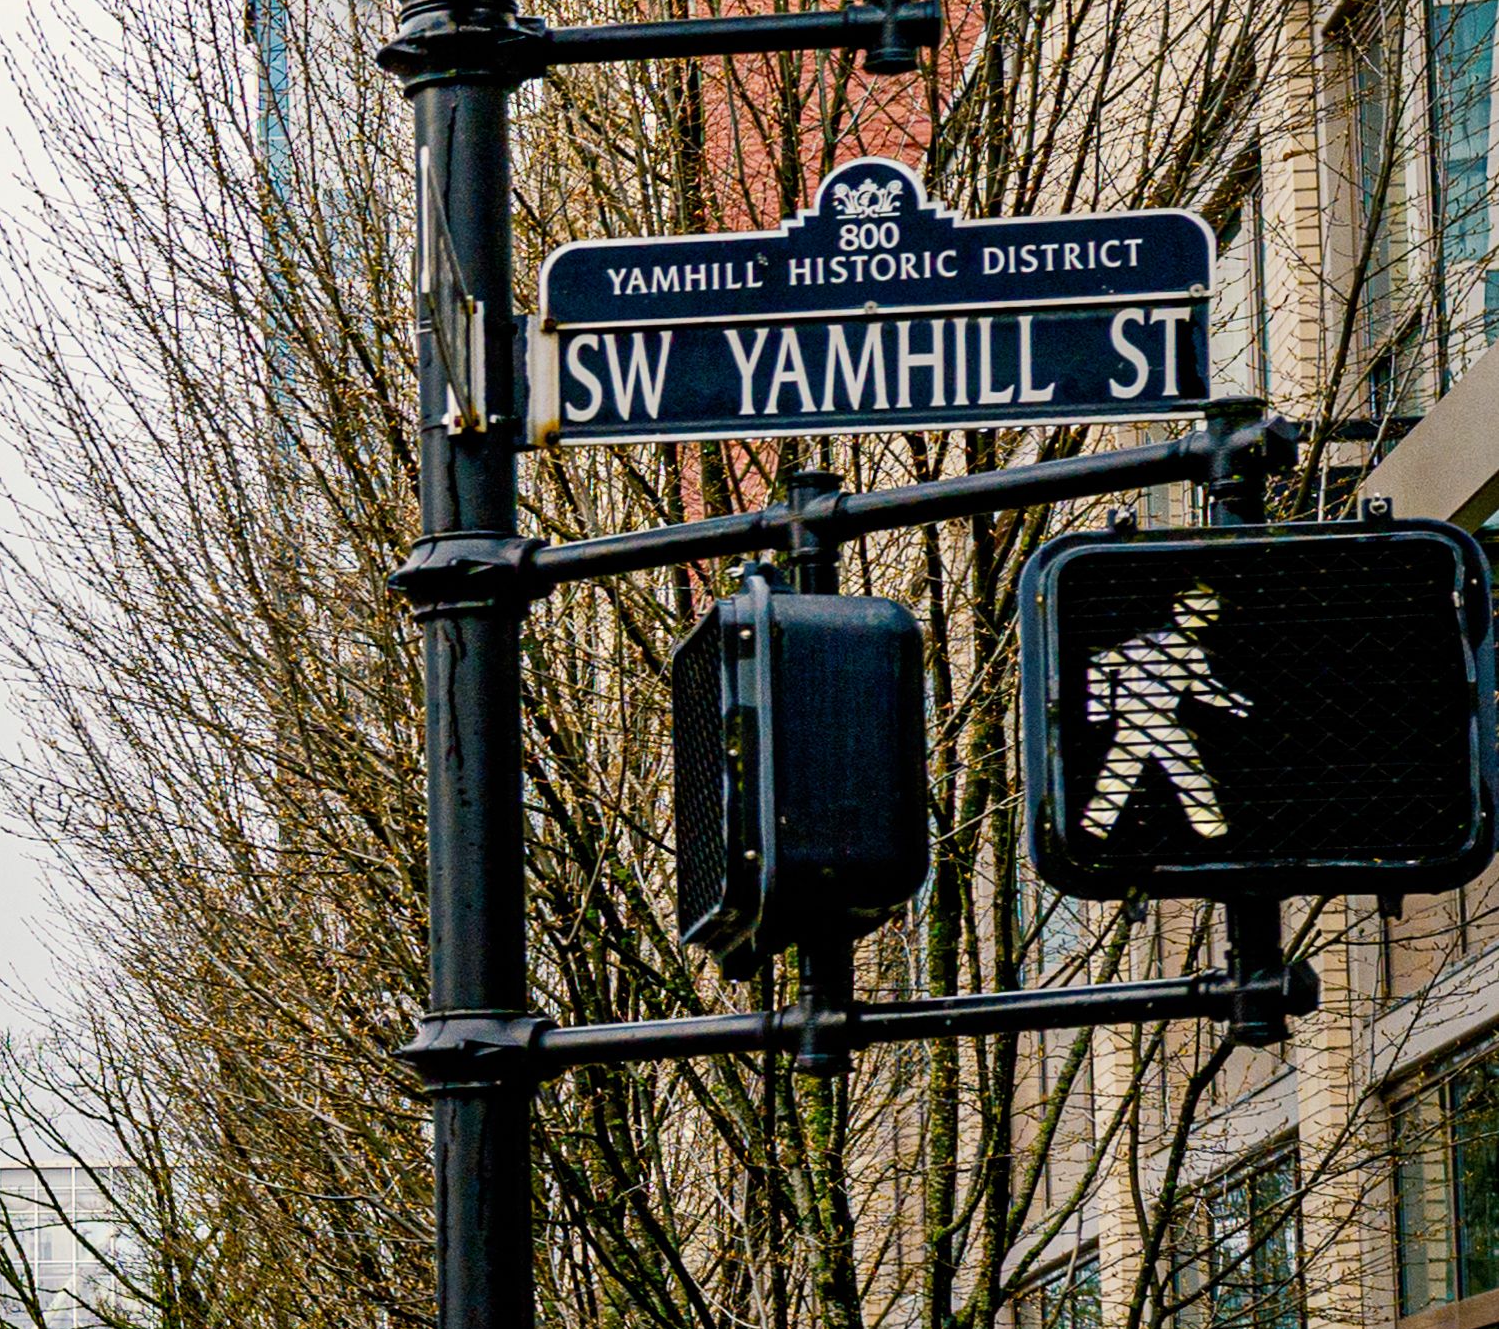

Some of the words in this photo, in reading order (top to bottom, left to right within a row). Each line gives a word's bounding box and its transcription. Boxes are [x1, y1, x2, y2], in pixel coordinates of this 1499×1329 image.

[839, 222, 900, 251] 800
[606, 261, 763, 296] YAMHILL
[789, 250, 958, 286] HISTORIC
[982, 238, 1143, 275] DISTRICT
[564, 330, 673, 422] SW
[724, 315, 1056, 416] YAMHILL
[1108, 307, 1194, 400] ST
